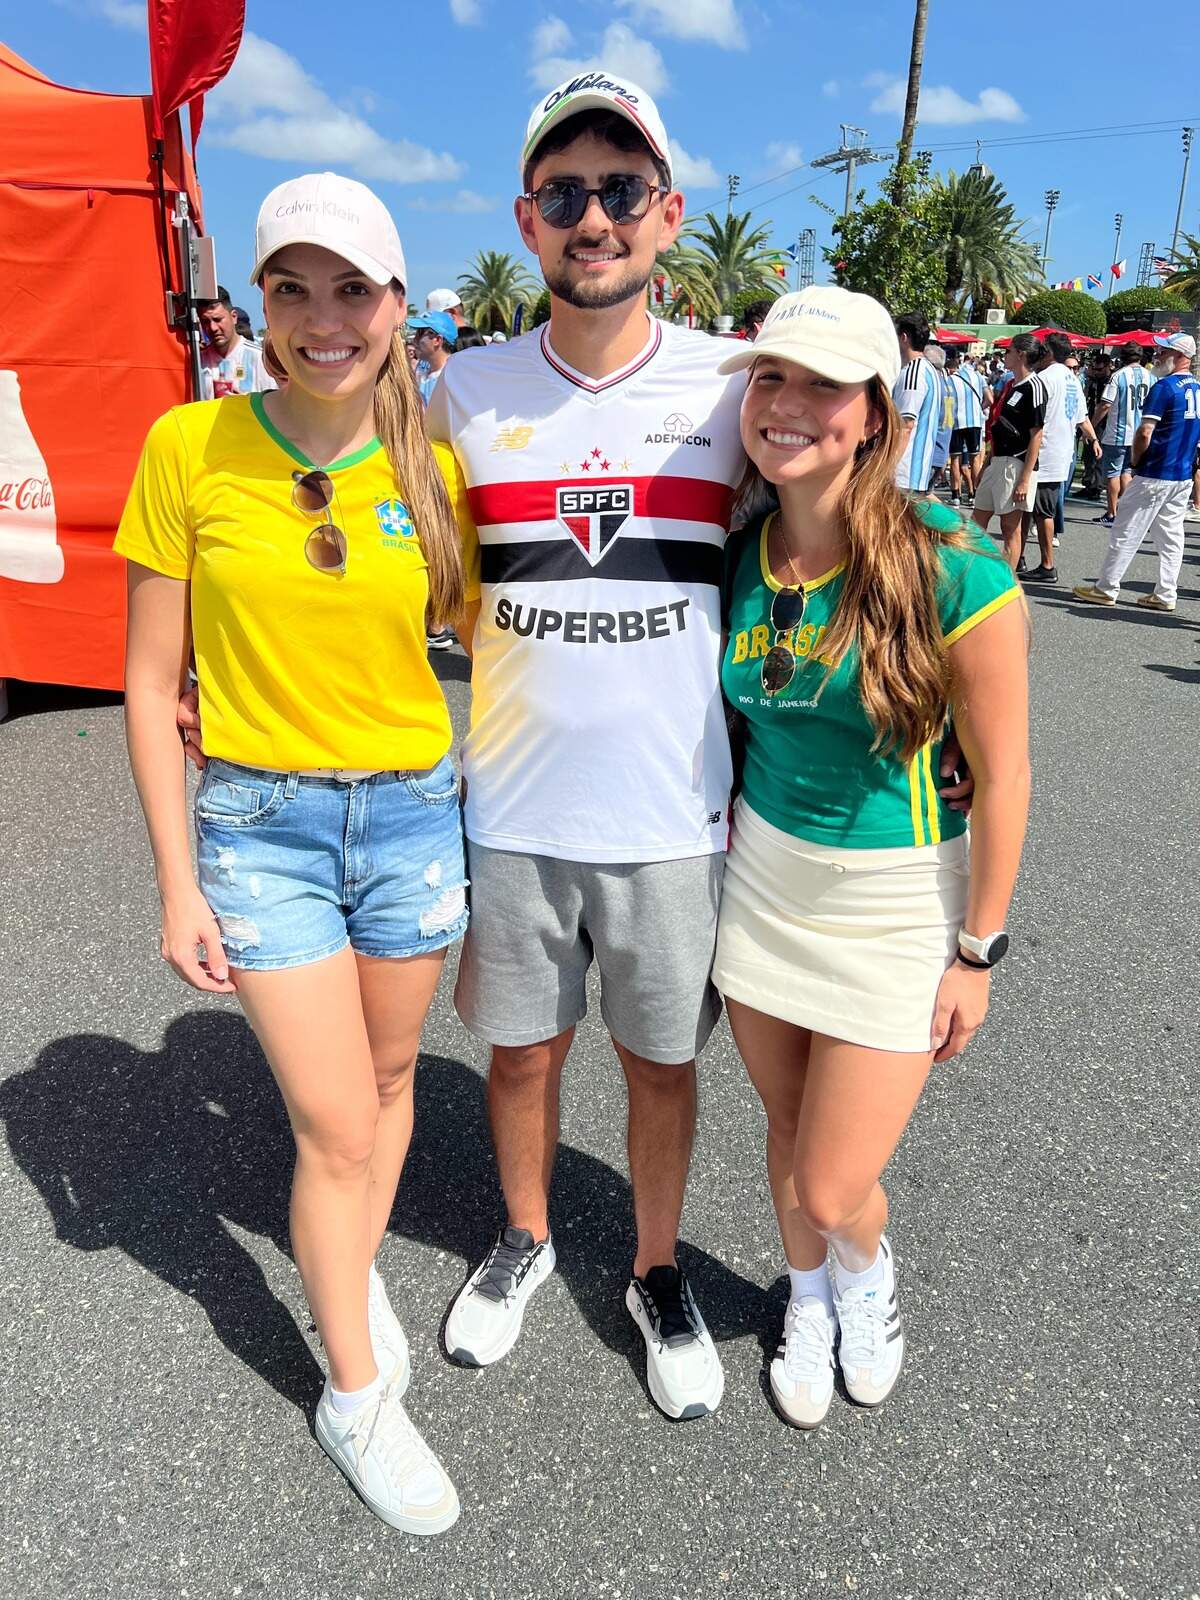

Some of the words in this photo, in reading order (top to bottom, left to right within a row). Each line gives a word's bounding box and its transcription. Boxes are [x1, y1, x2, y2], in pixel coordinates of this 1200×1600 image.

[544, 73, 639, 112] Milano
[323, 201, 360, 224] Klein
[644, 433, 711, 448] ADEMICON
[563, 490, 627, 511] SPFC
[382, 539, 417, 554] BRASIL
[494, 598, 691, 644] SUPERBET
[738, 695, 754, 704] RIO
[760, 698, 772, 706] DE
[777, 700, 818, 708] JANEIRO
